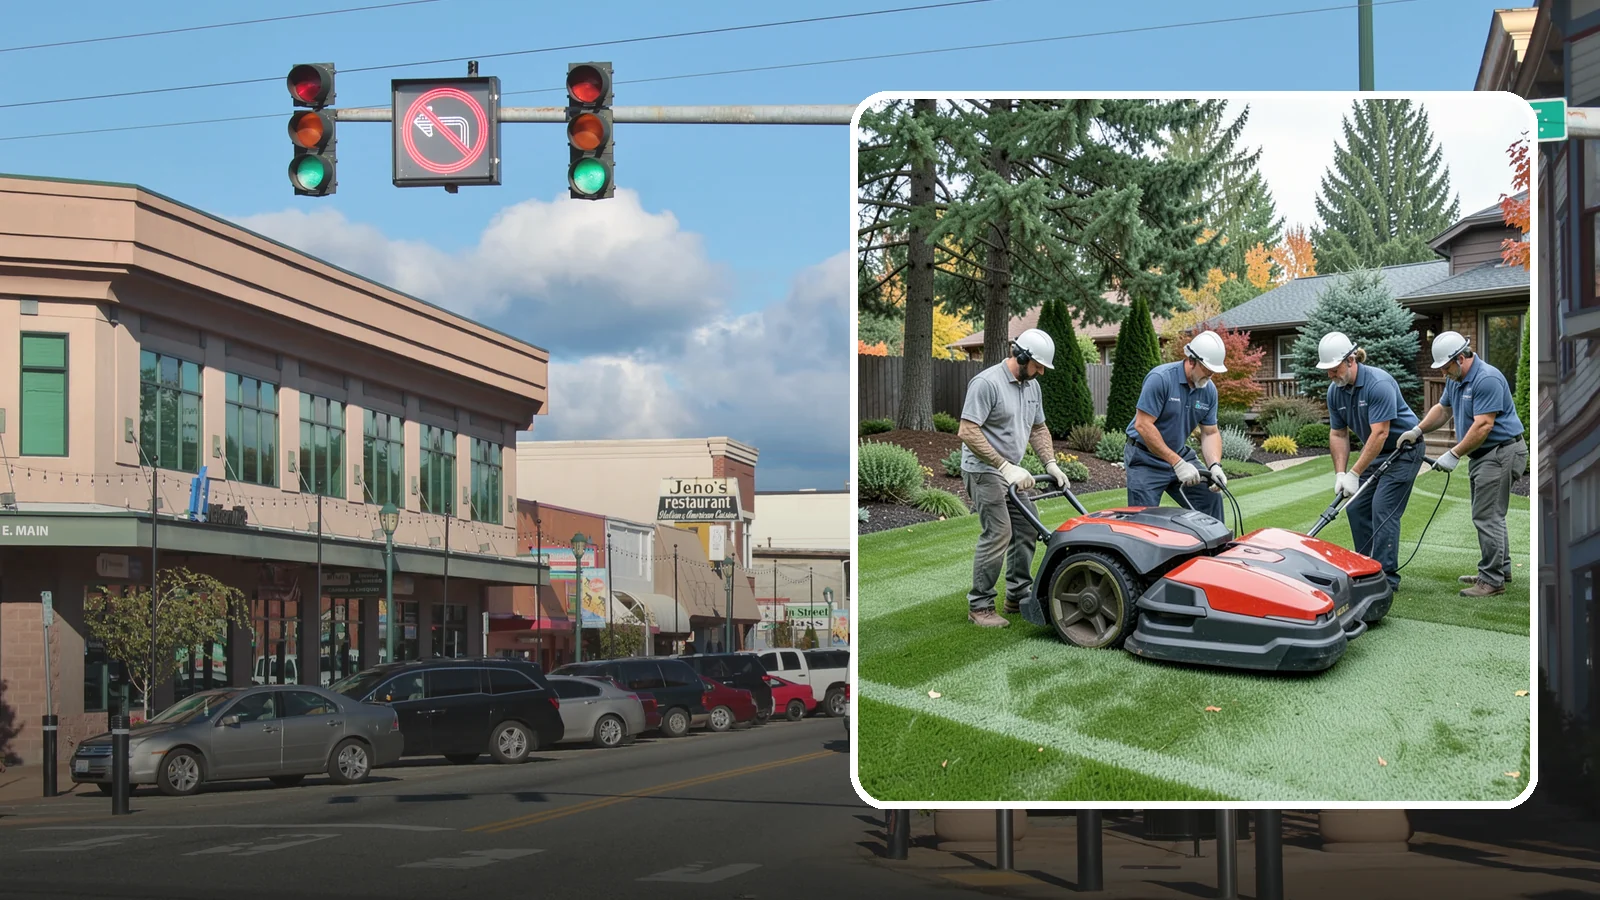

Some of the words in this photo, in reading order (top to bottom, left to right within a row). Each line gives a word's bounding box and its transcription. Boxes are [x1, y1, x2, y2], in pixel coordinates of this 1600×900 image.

[670, 480, 727, 494] Jeno's
[665, 496, 731, 509] restaurant
[659, 510, 682, 520] Italian
[686, 509, 714, 519] American
[715, 509, 737, 519] Cuisine
[2, 525, 13, 536] E.
[15, 525, 49, 536] MAIN
[786, 607, 794, 616] in
[797, 607, 828, 616] Street
